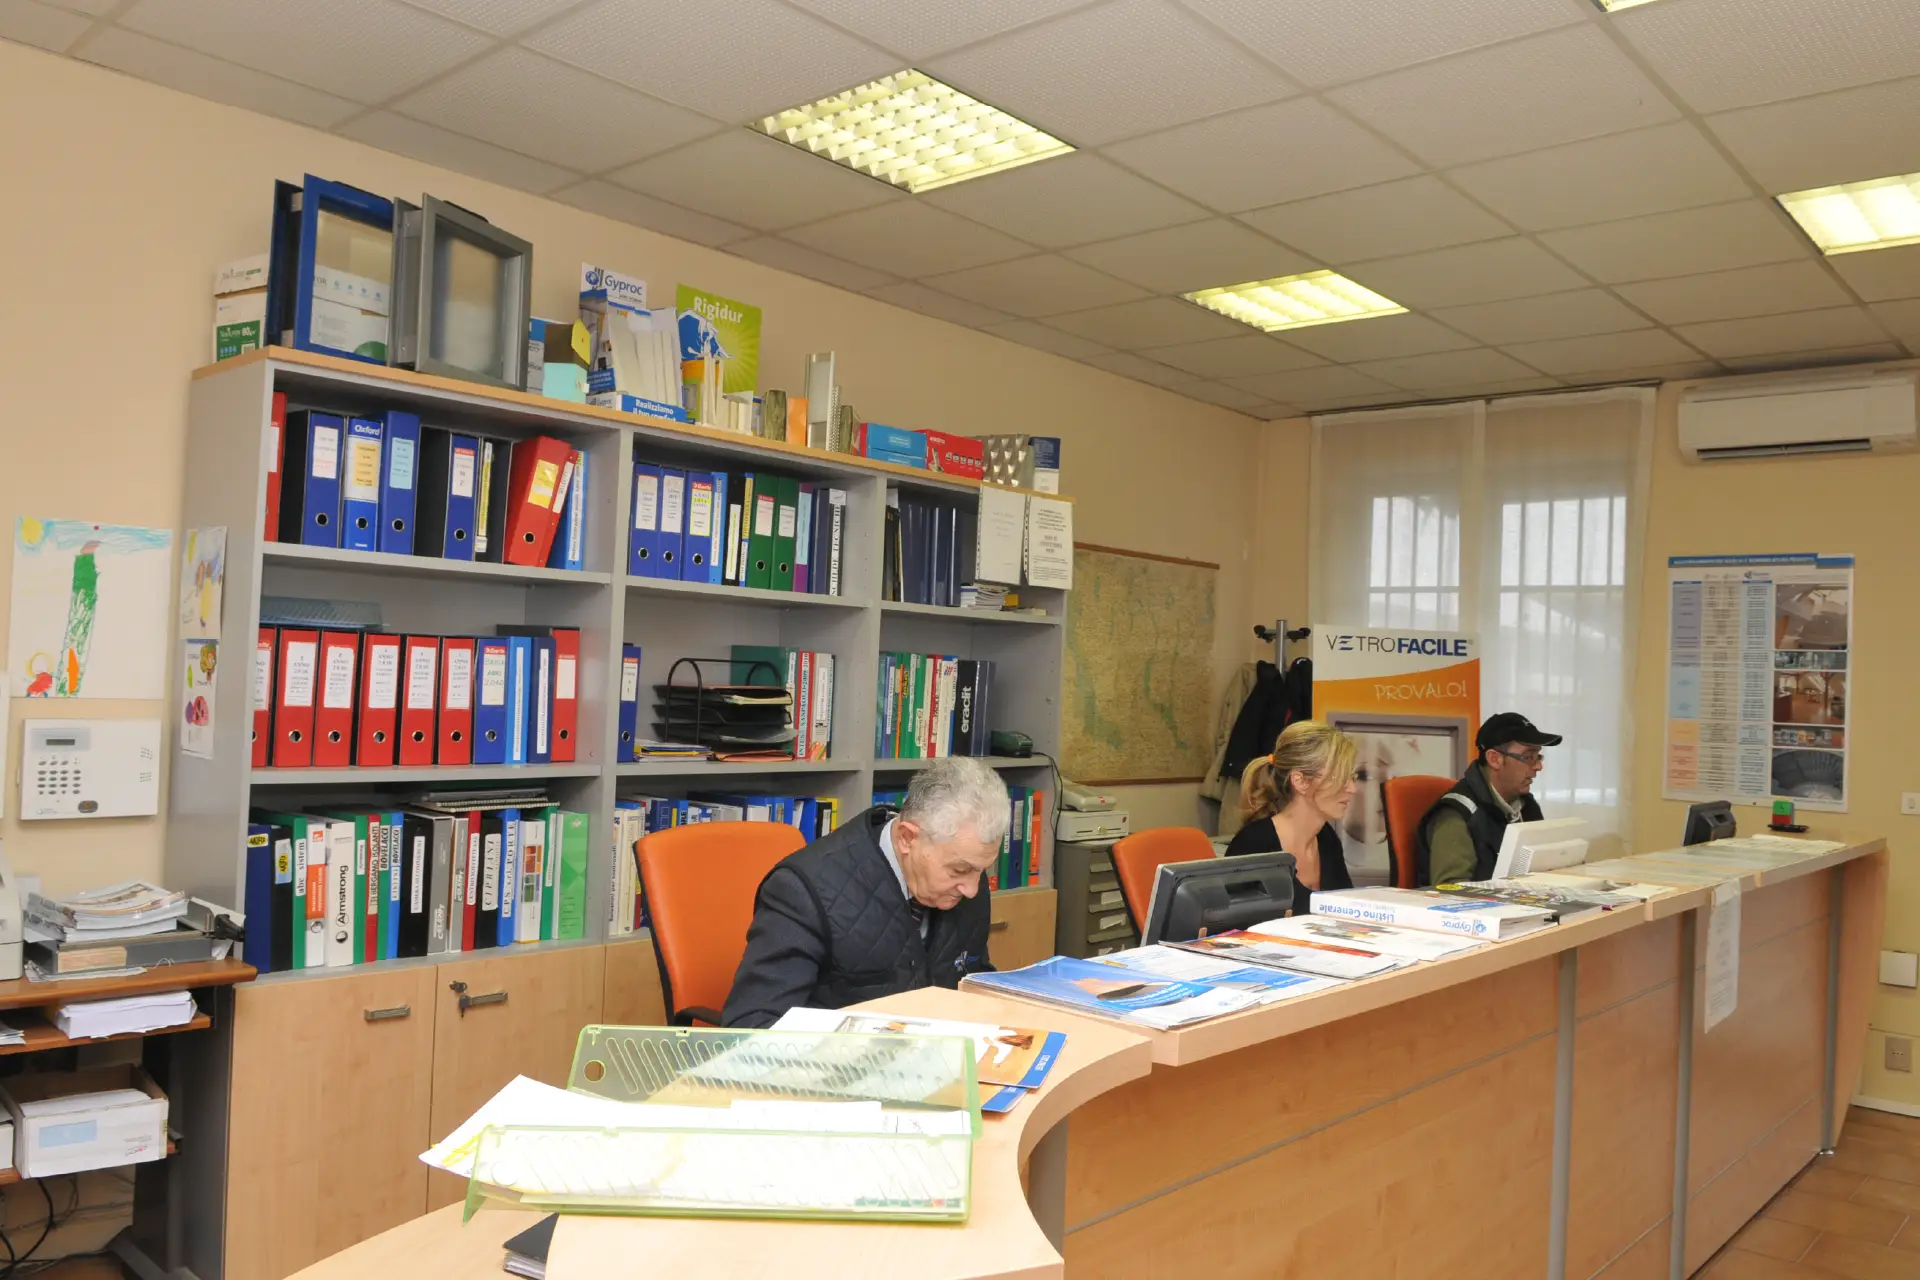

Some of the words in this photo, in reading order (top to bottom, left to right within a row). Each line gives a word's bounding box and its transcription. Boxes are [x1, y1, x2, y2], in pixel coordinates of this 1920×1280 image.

[604, 274, 643, 296] Gyproc
[693, 296, 744, 324] Rigidur
[635, 399, 674, 415] Realizziamo
[354, 424, 381, 435] Oxford
[1326, 635, 1468, 657] VETROFACILE
[1375, 680, 1468, 700] PROVALO!
[960, 686, 972, 733] eraclit
[371, 826, 379, 858] ISOLANTI
[380, 828, 389, 868] BOVELACCI
[392, 830, 400, 864] BOVELACCI
[506, 822, 515, 865] PORTE
[297, 842, 305, 870] sistem
[484, 839, 494, 906] CIPRIANI
[296, 877, 305, 894] abc
[338, 865, 349, 924] Armstrong
[1319, 904, 1360, 919] Generale
[1363, 910, 1395, 923] Listino
[1441, 920, 1472, 932] Gyproc
